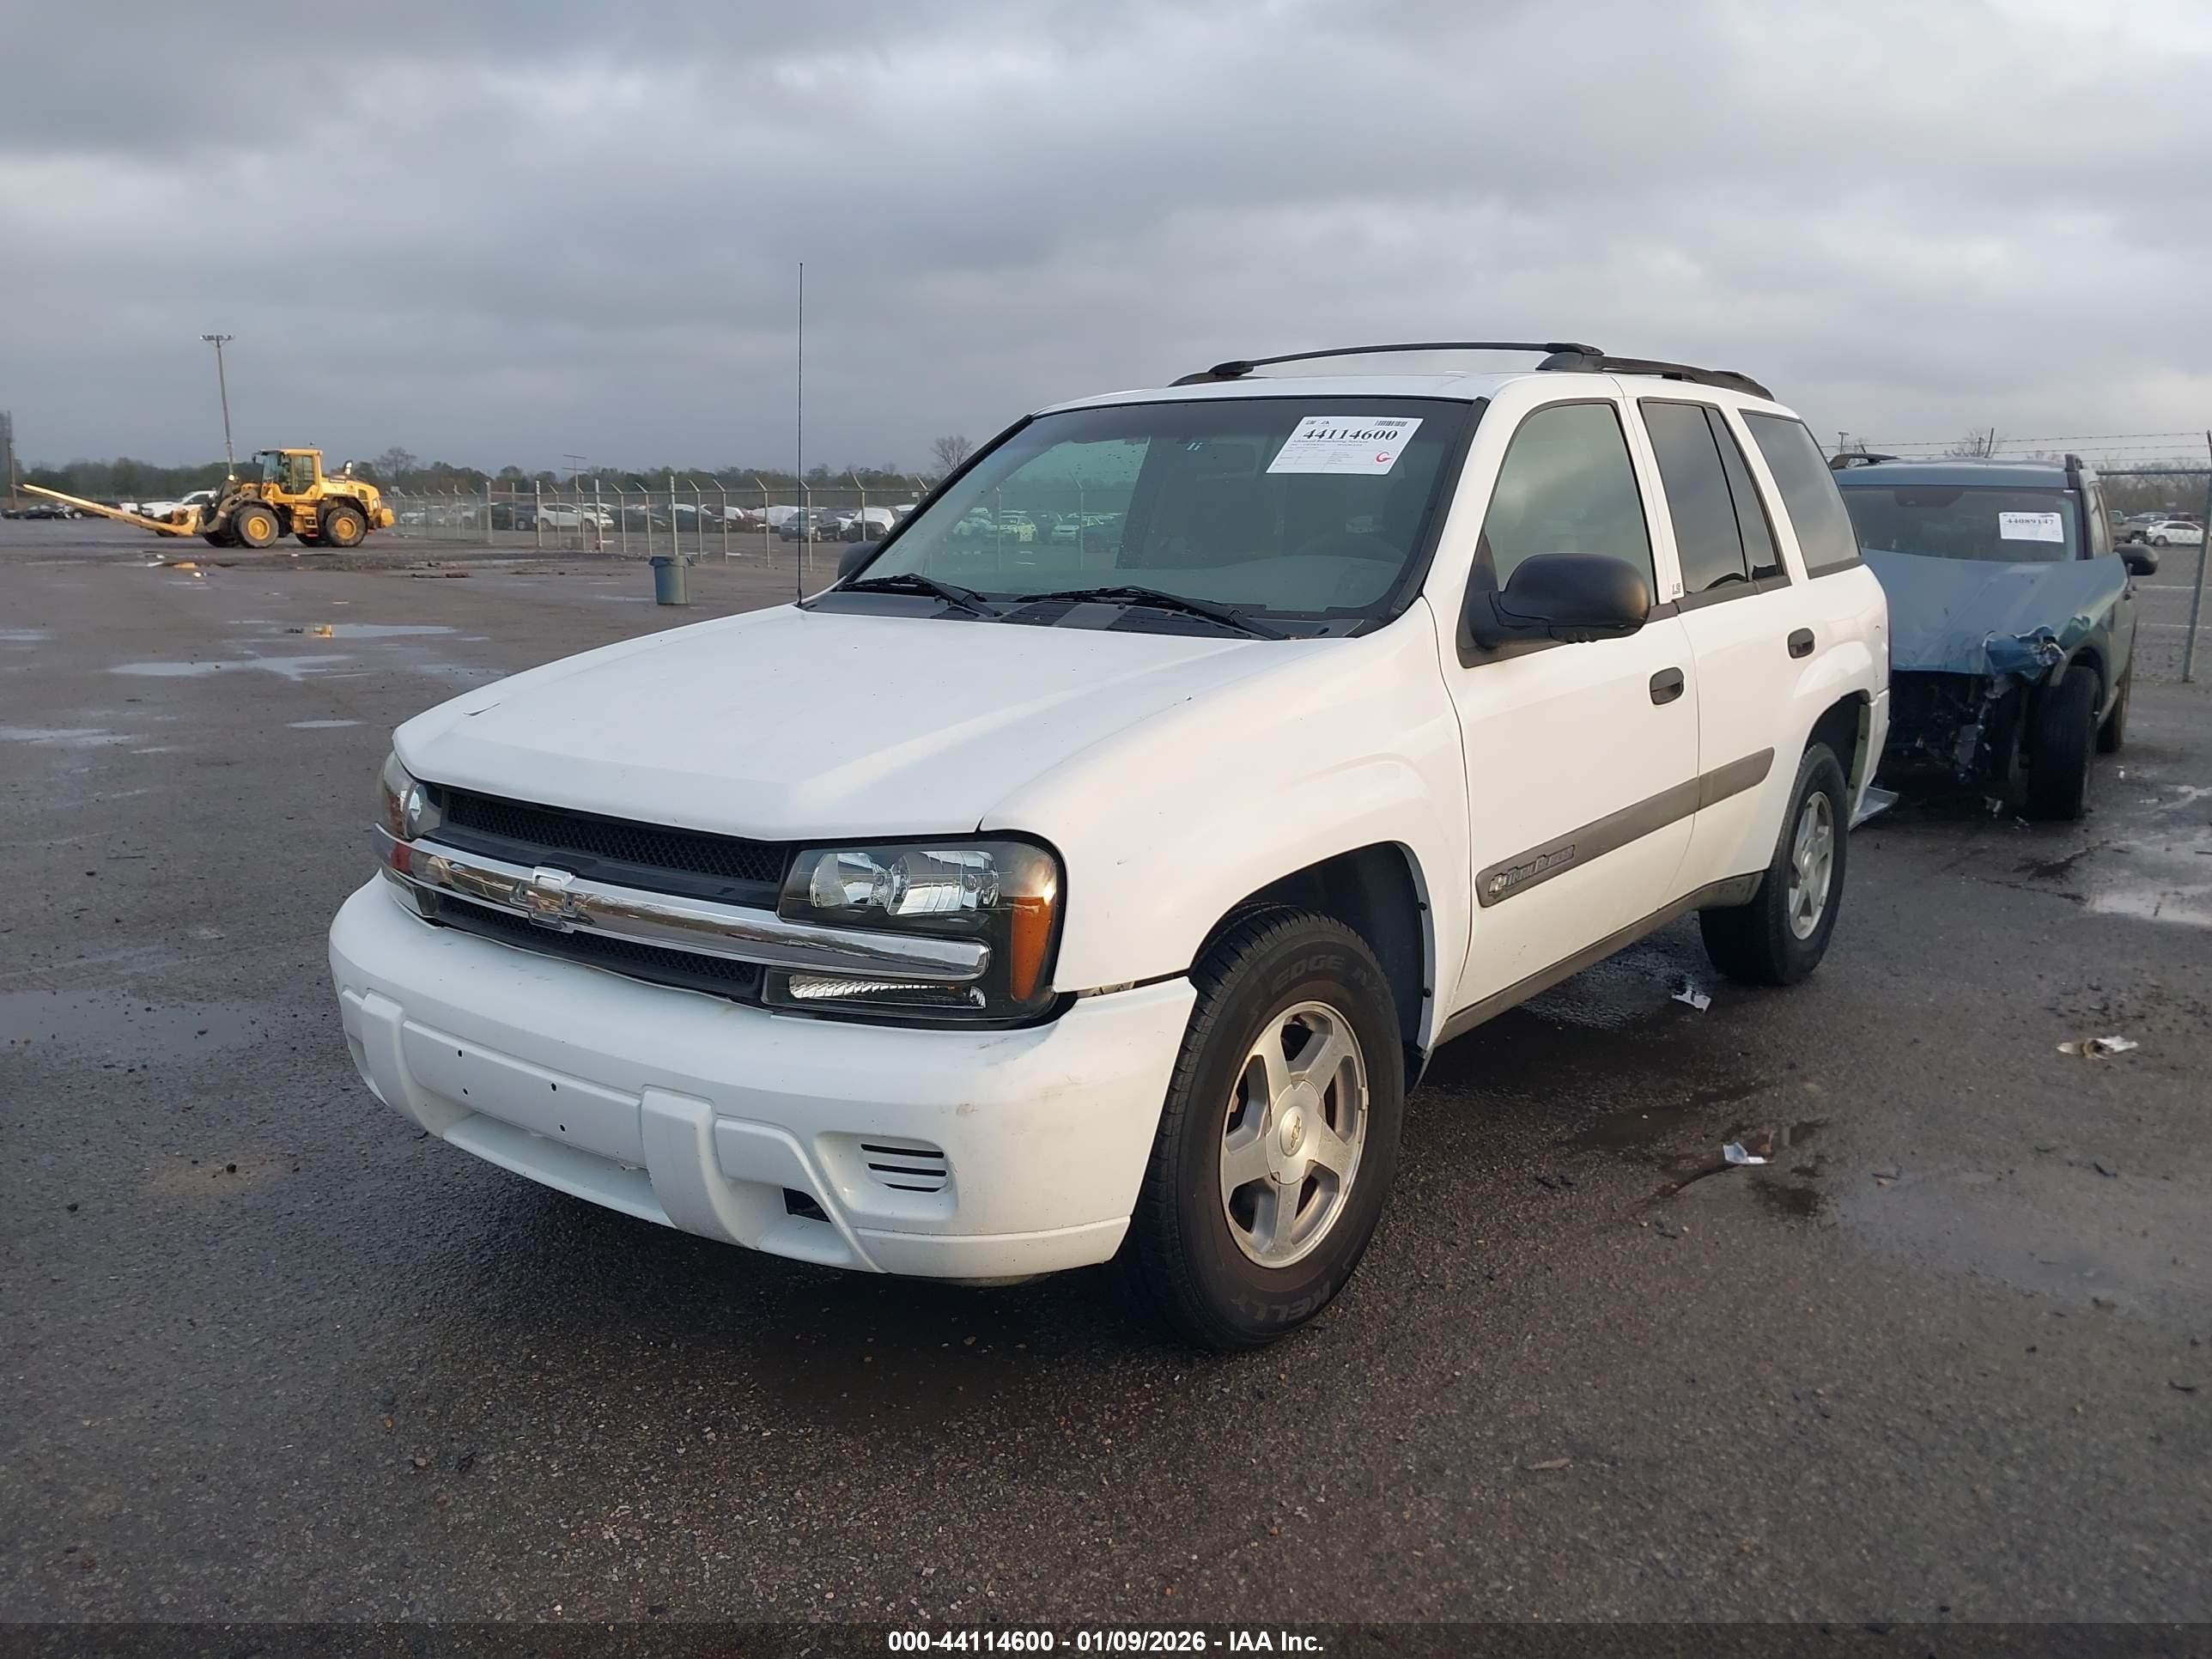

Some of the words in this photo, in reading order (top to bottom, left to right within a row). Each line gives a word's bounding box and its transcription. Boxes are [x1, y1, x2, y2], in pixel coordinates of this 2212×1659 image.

[1303, 428, 1399, 441] 44114600
[1271, 955, 1345, 994] EDGE
[1230, 1280, 1331, 1322] KELLY
